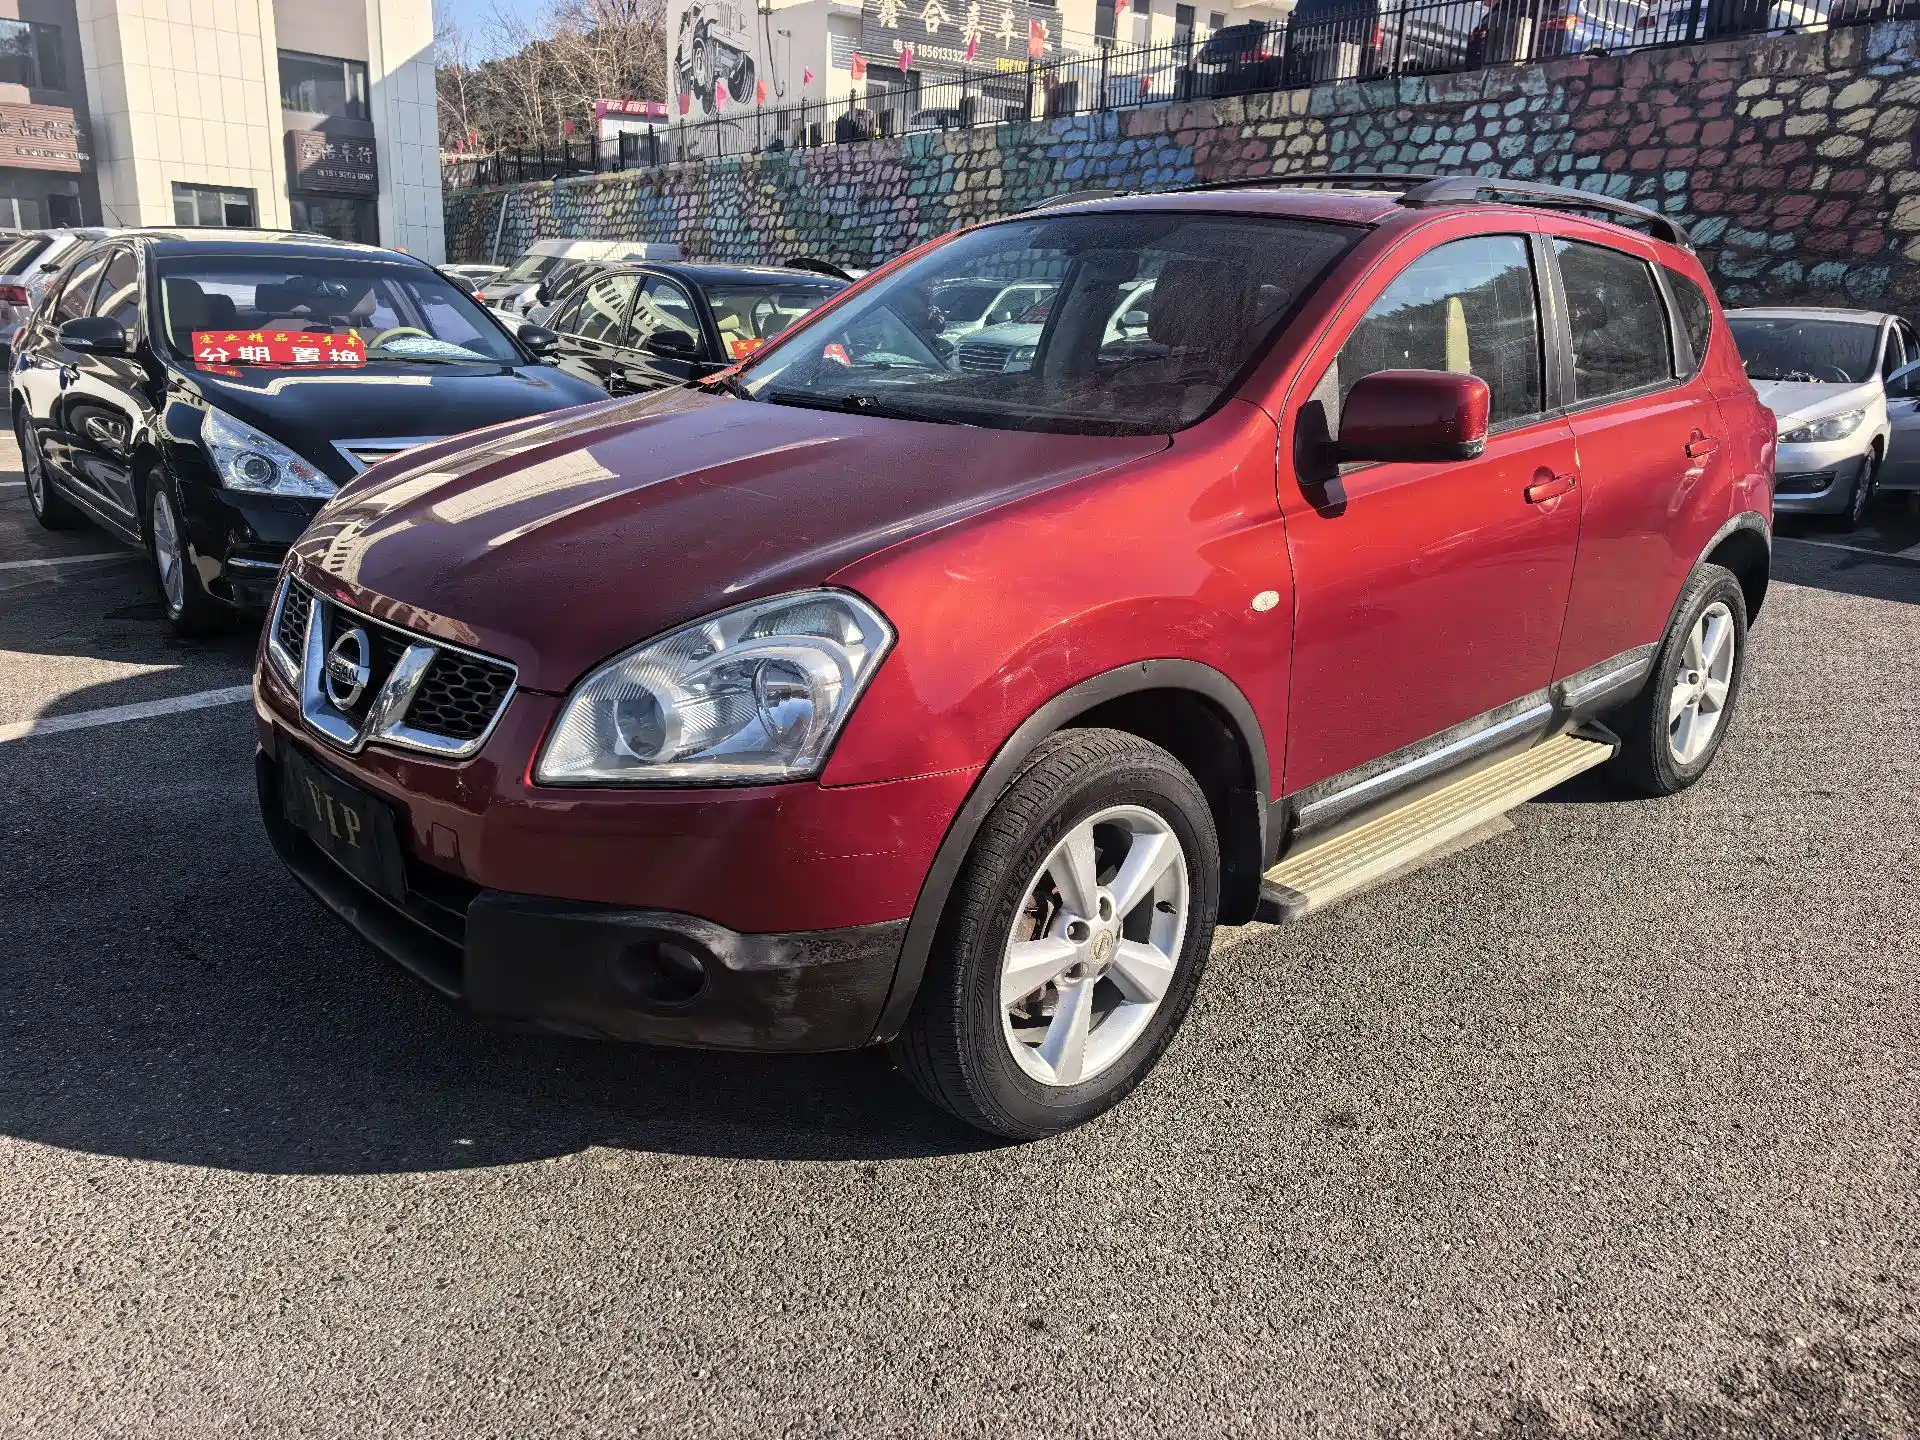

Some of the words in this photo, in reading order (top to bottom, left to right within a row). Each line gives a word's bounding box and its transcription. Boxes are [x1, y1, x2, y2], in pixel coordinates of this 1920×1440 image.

[199, 346, 271, 362] 分期
[292, 347, 361, 363] 置换
[303, 775, 361, 849] VIP
